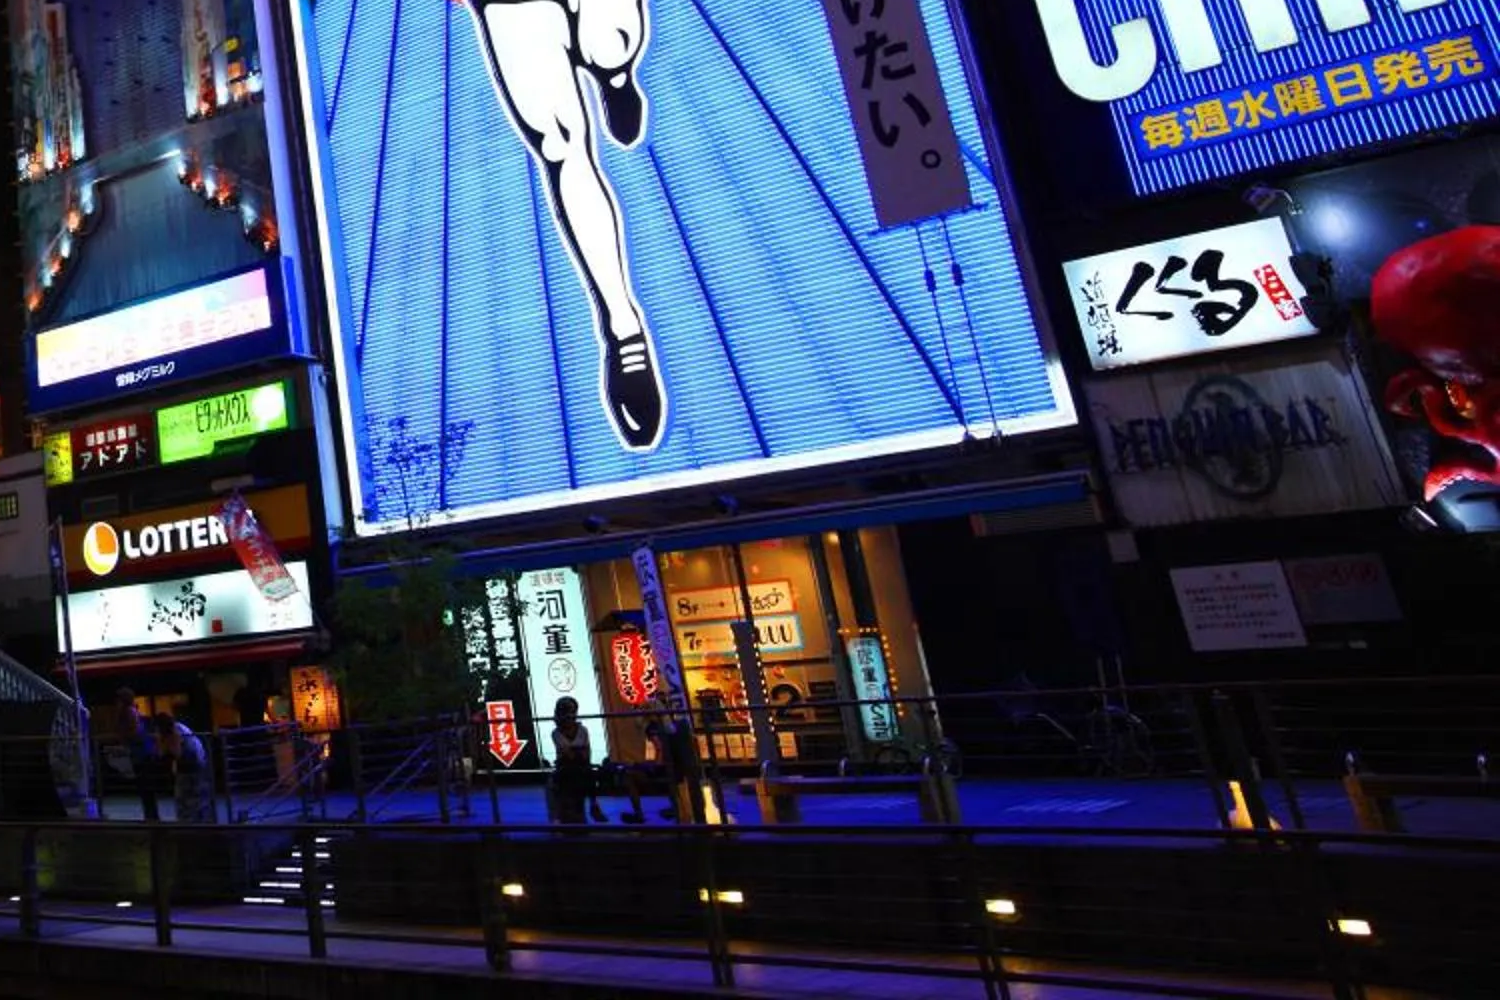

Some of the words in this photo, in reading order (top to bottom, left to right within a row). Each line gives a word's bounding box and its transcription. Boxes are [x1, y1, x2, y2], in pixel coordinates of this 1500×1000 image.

[1139, 34, 1486, 151] 毎週水曜日発売
[1115, 249, 1259, 336] くくる
[124, 508, 257, 558] LOTTER
[536, 589, 573, 656] 河童
